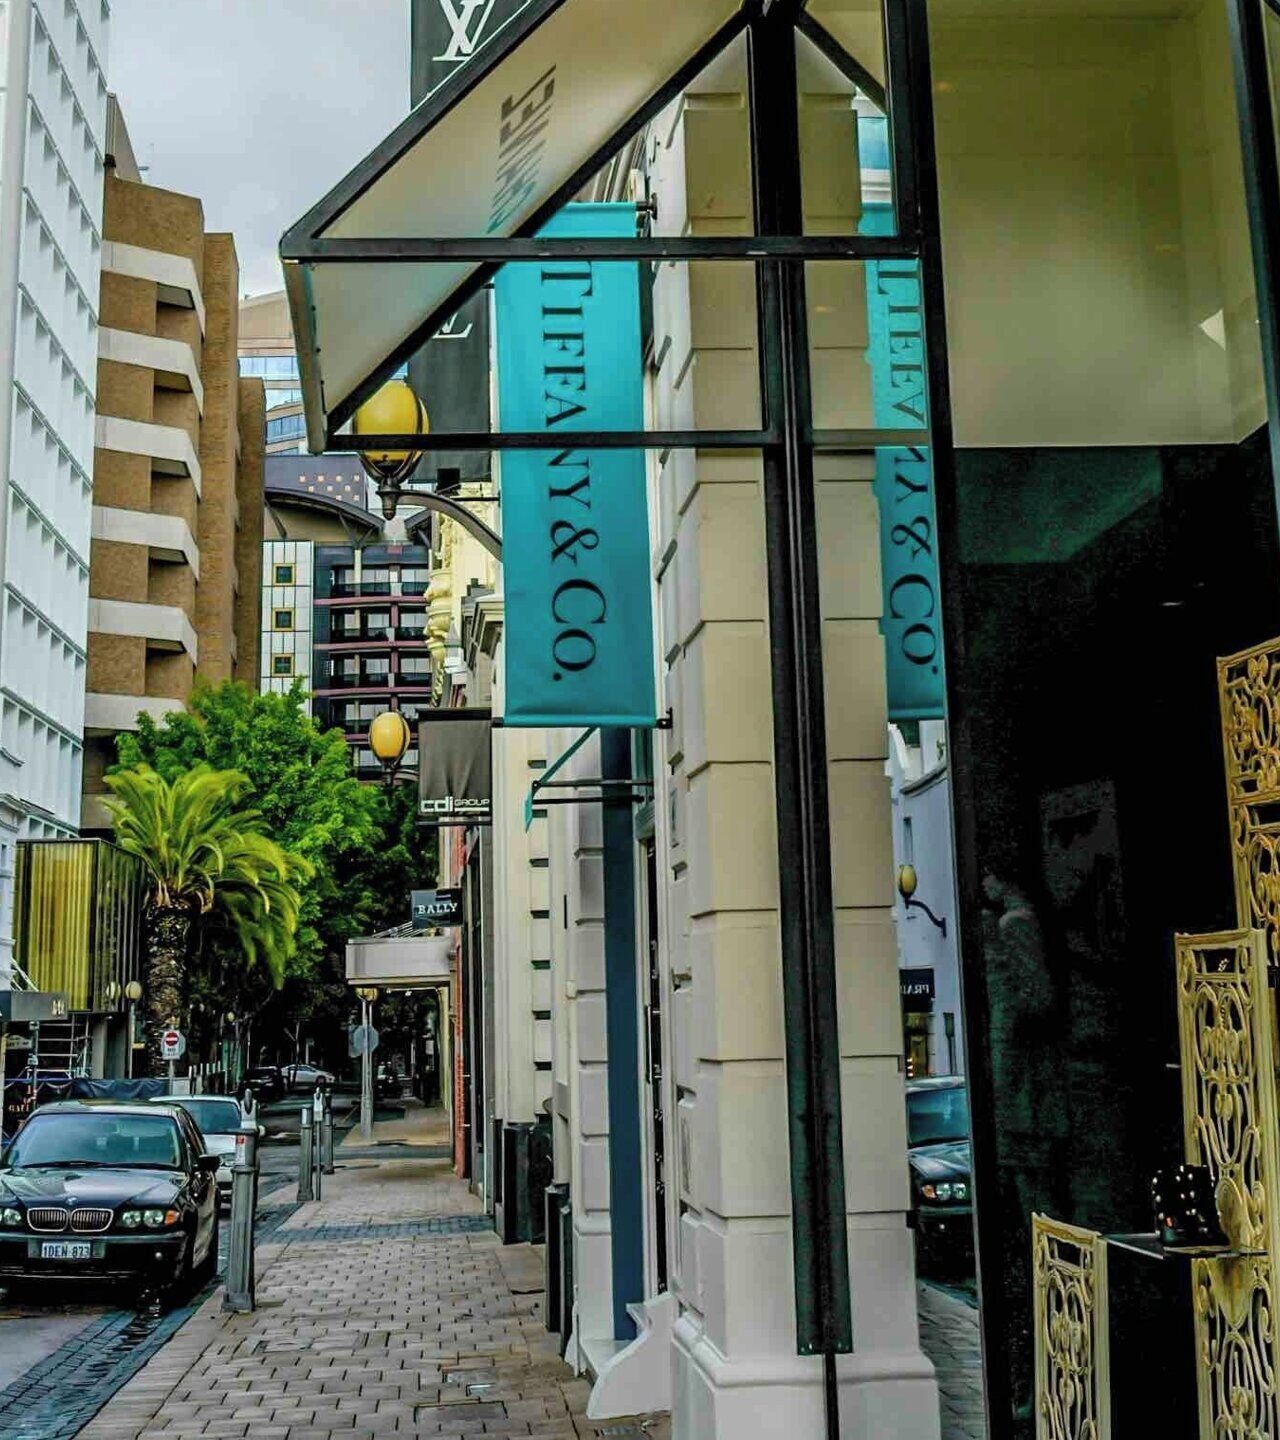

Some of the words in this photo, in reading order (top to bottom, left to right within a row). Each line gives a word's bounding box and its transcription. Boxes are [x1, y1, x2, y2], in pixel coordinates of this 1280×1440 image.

[550, 519, 601, 563] &
[420, 796, 453, 813] cdi
[454, 798, 490, 809] GROUP
[418, 901, 459, 916] BALLY
